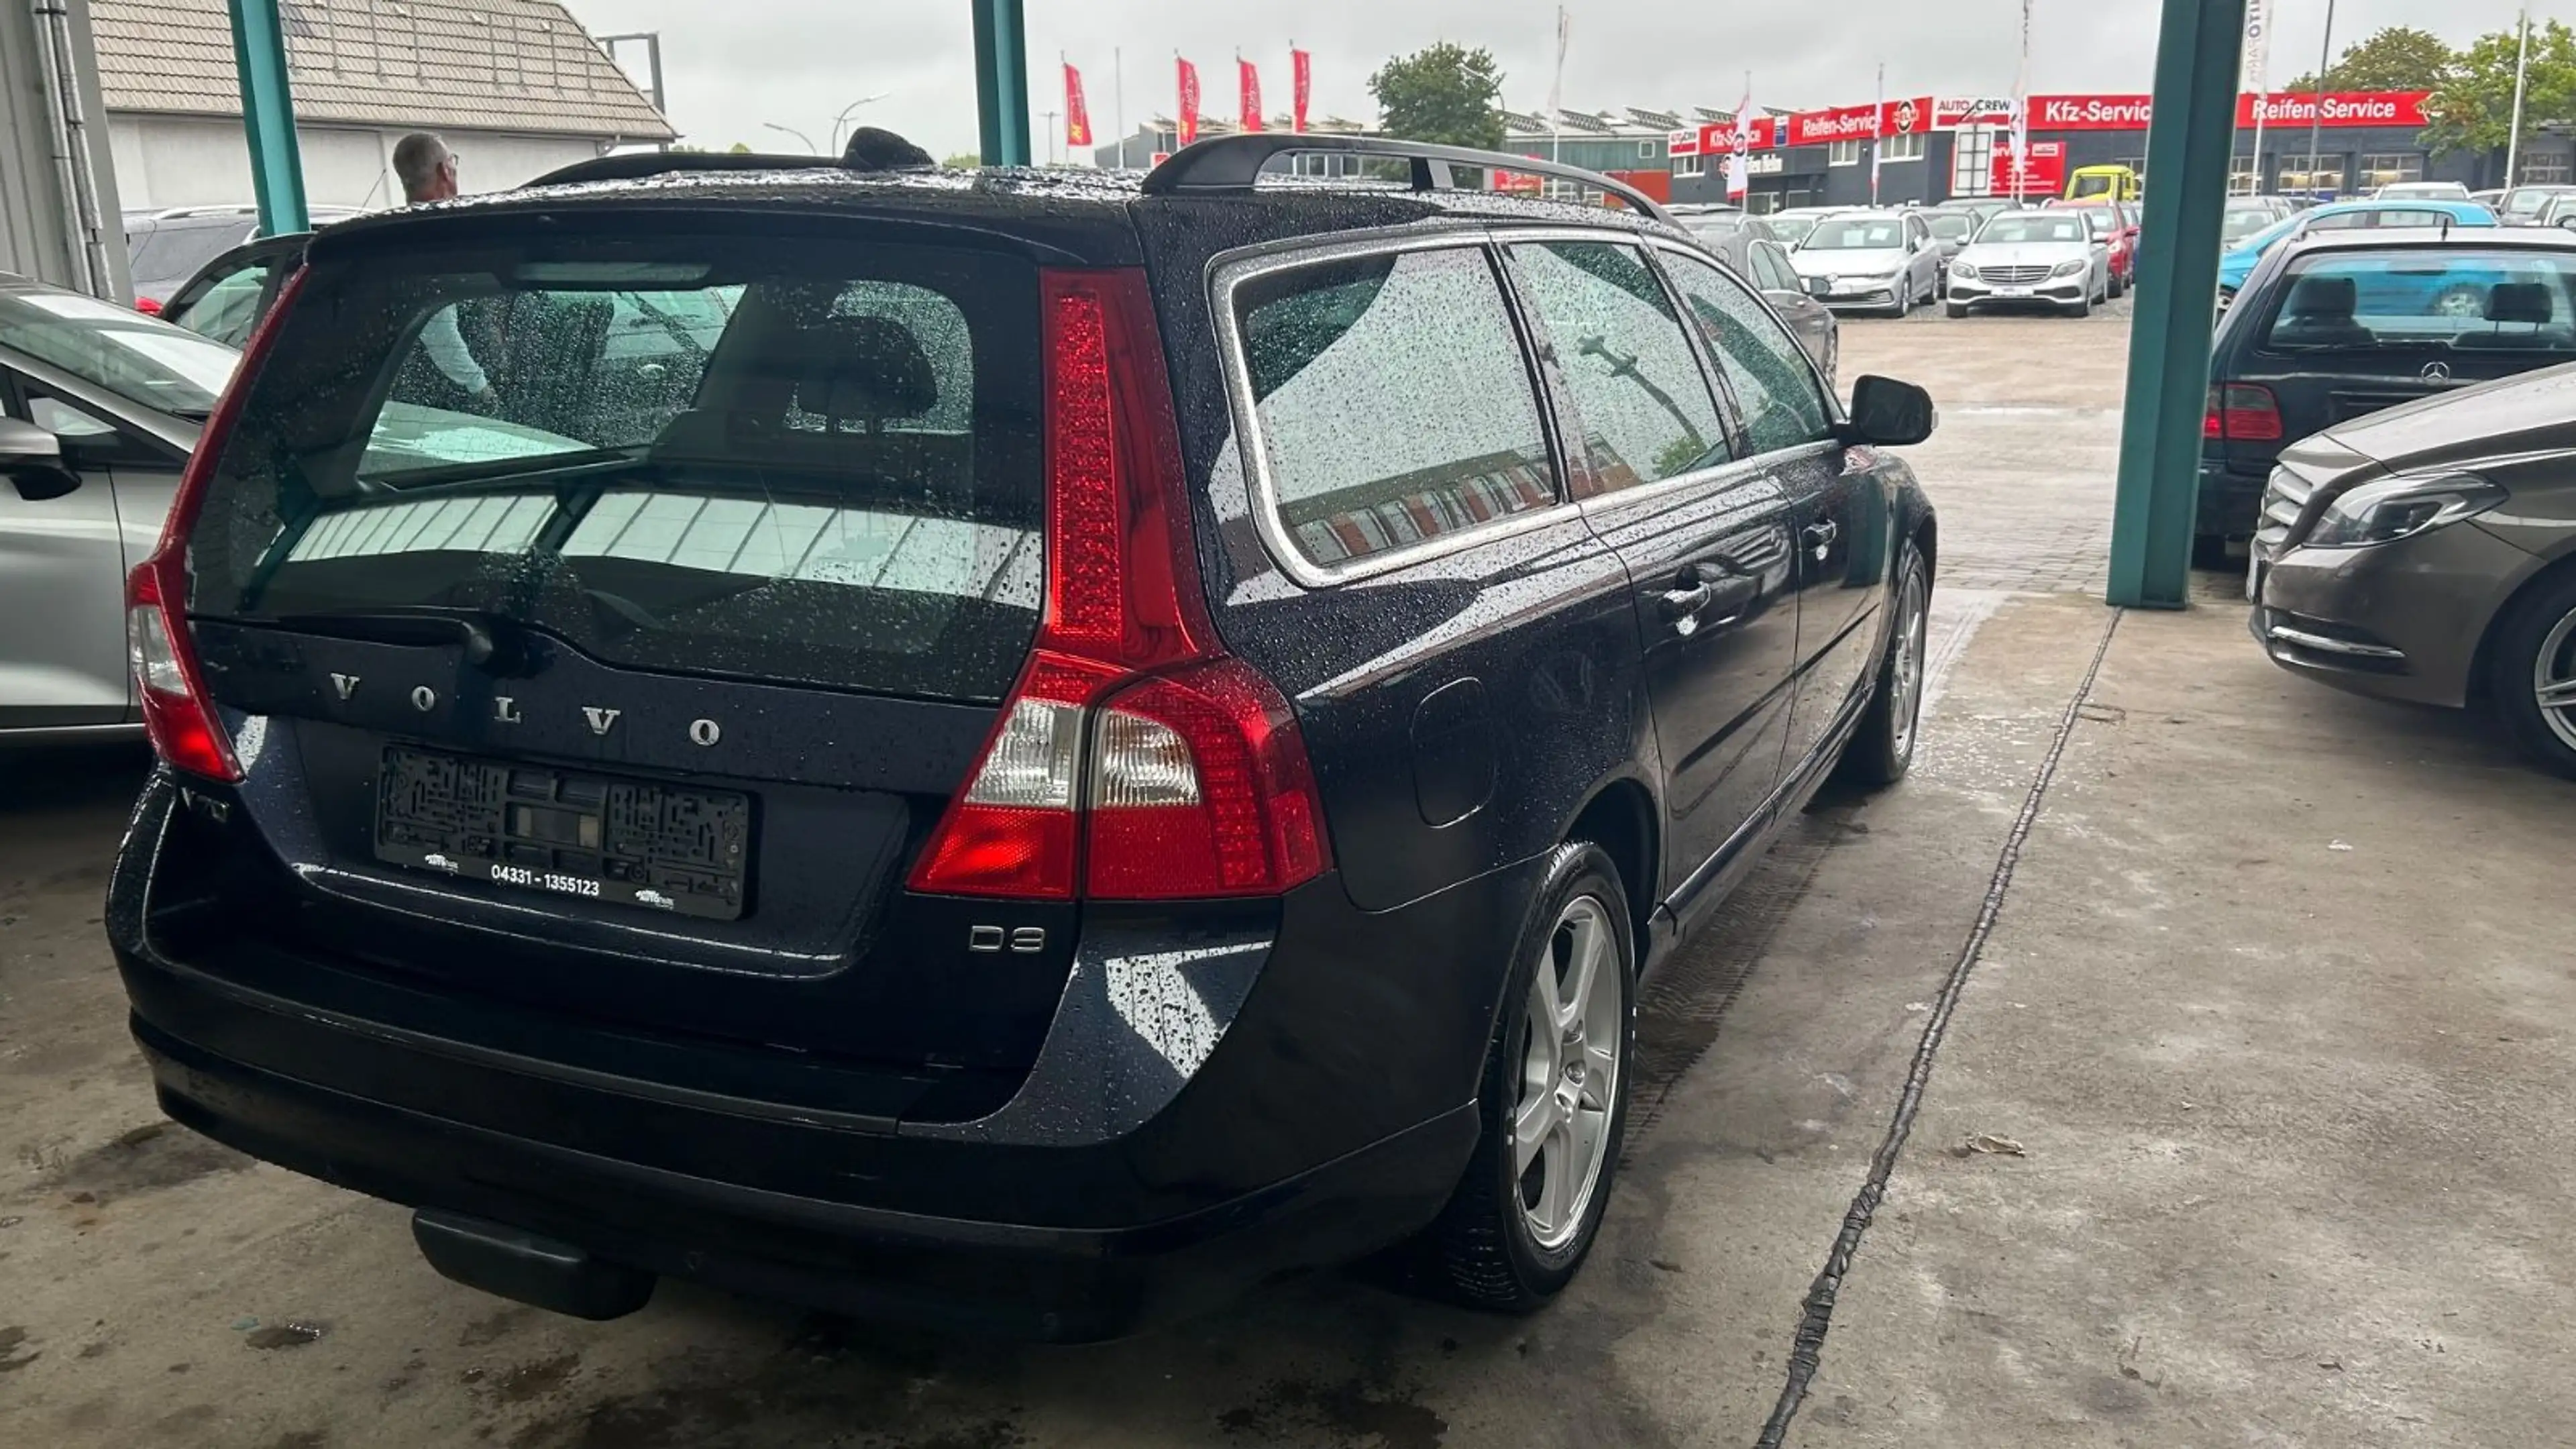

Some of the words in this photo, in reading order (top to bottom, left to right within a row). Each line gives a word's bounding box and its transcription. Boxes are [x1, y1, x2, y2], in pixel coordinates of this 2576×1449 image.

[1937, 100, 1970, 111] AUTO
[1976, 99, 2010, 111] CREW
[2045, 100, 2151, 122] Kfz-Servic
[1803, 111, 1881, 137] Reifen-Servic
[329, 672, 721, 747] VOLVO
[490, 864, 532, 885] 04331
[543, 873, 600, 896] 1355123
[969, 925, 1045, 953] D3
